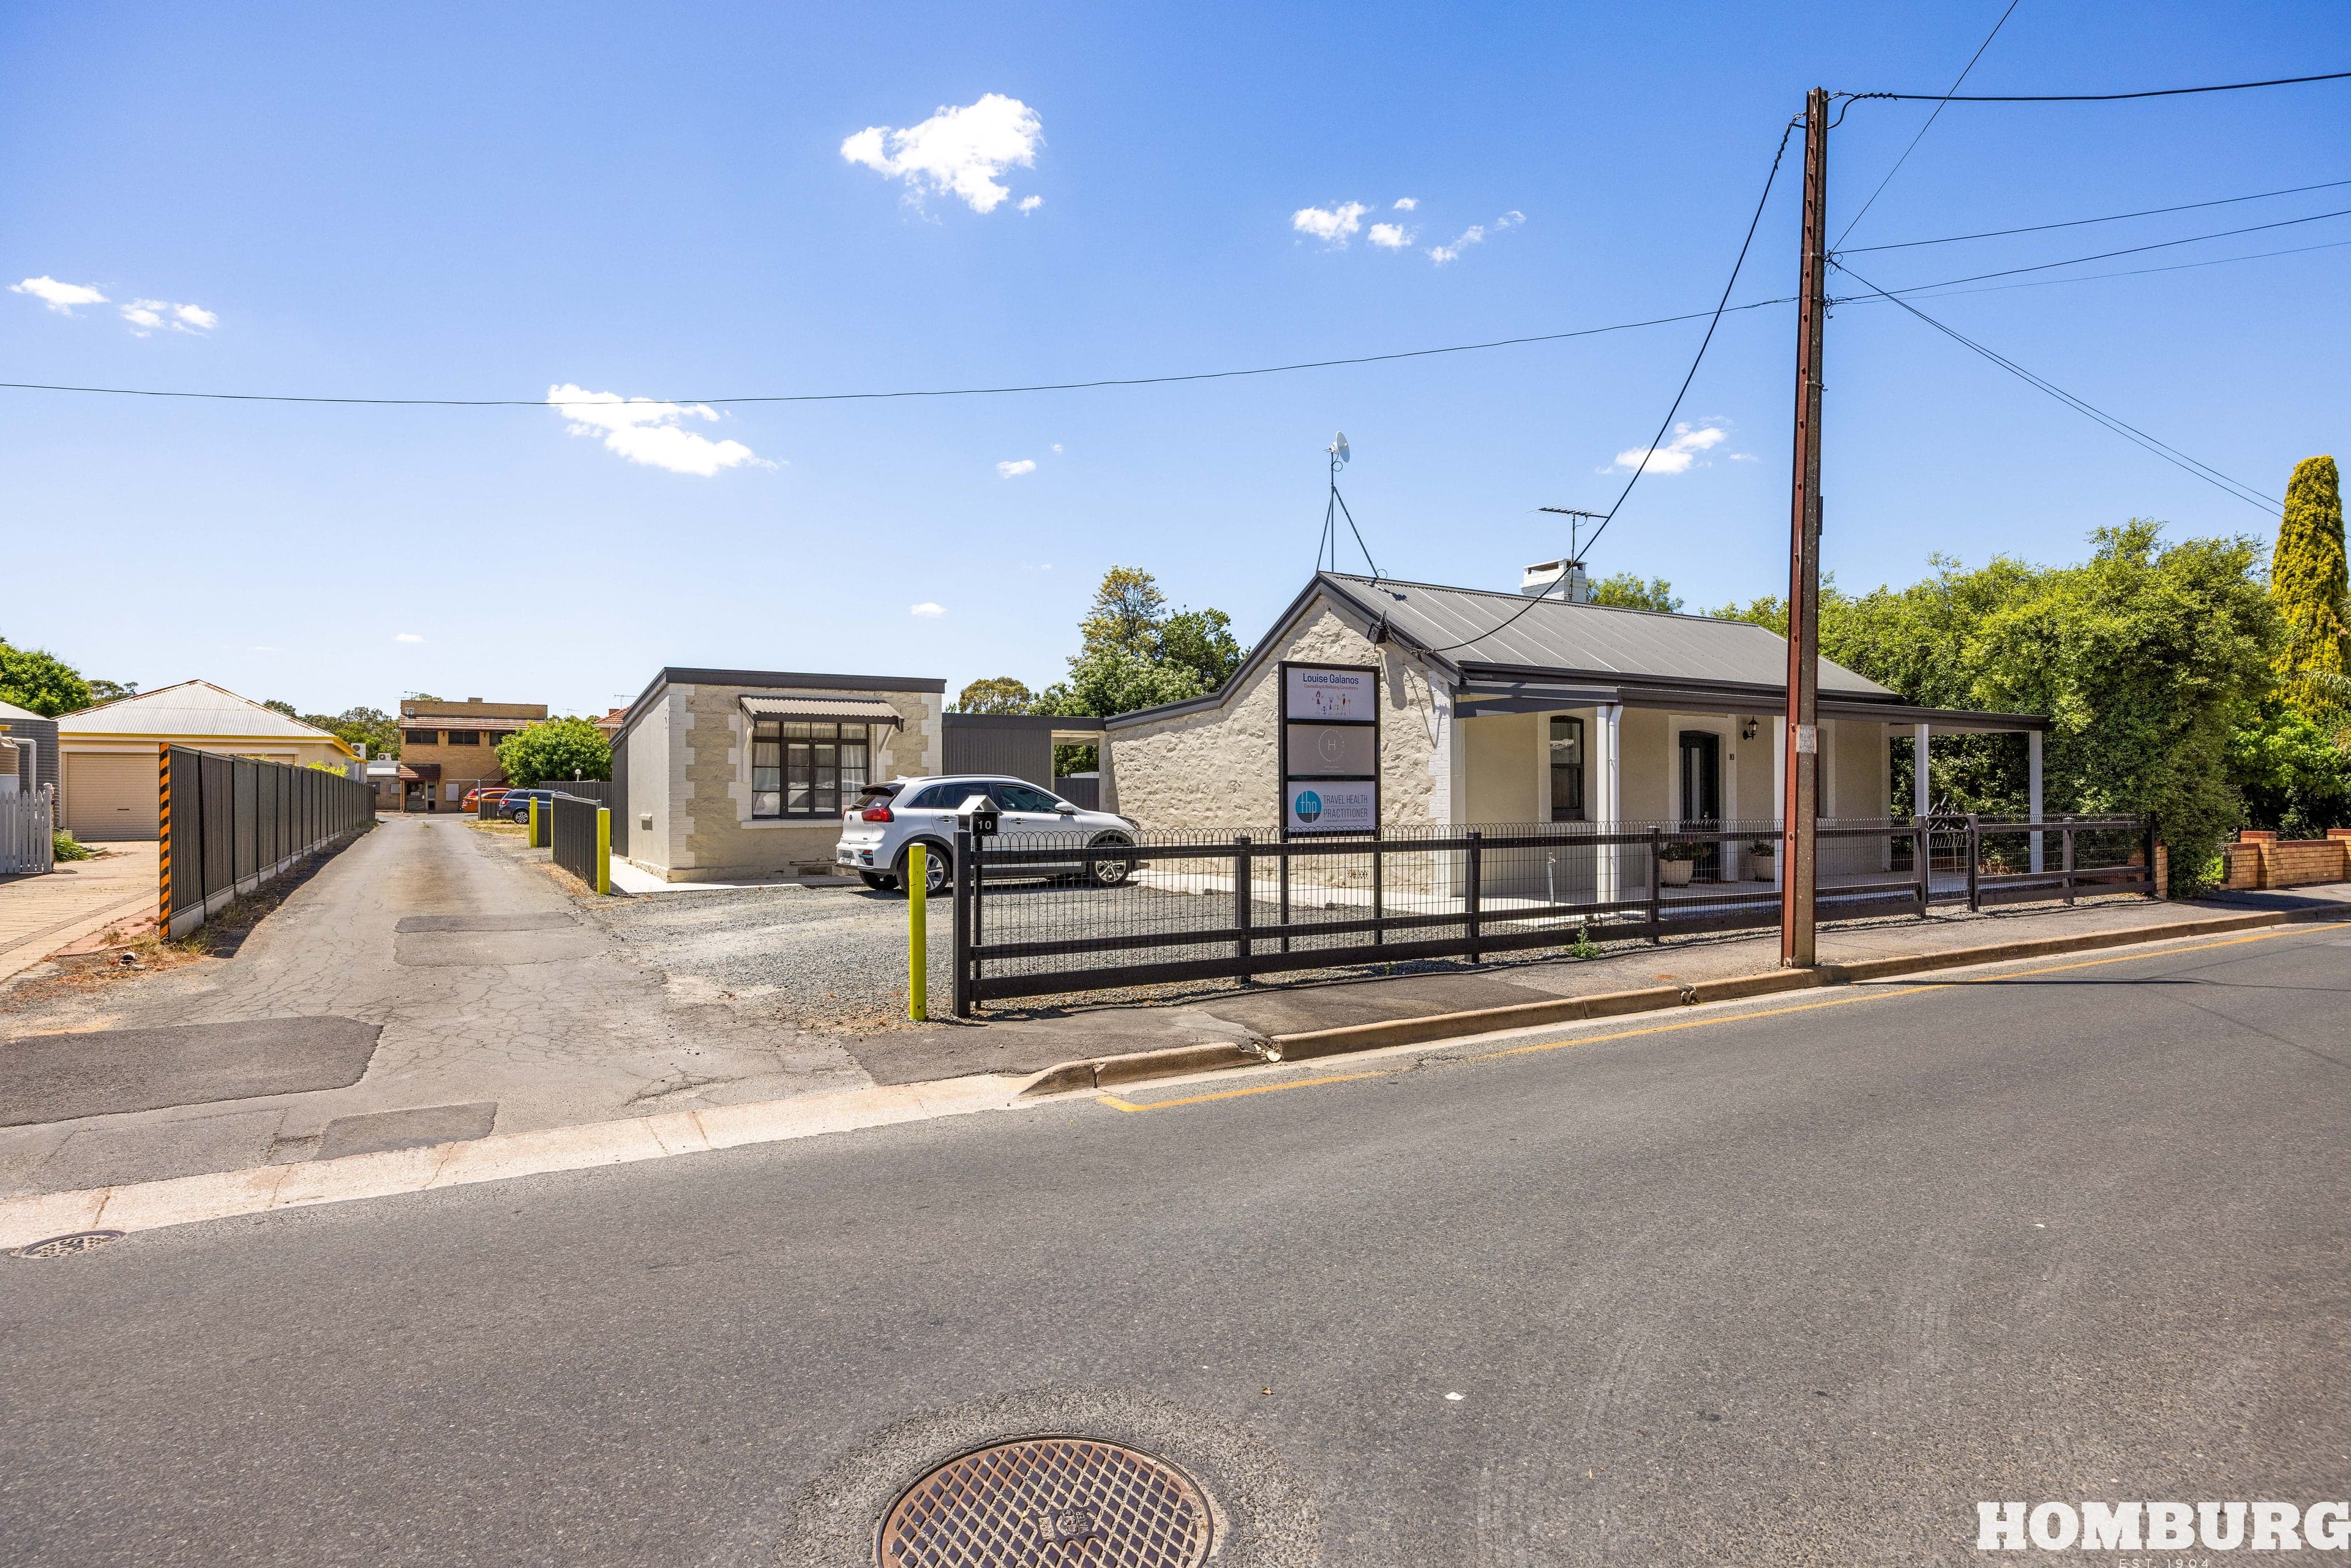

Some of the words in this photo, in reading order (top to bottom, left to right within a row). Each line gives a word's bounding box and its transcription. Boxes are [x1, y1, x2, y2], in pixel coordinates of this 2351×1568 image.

[1303, 673, 1328, 683] Louise
[1330, 674, 1359, 685] Galanos
[1328, 739, 1336, 751] H
[1323, 795, 1345, 804] TRAVEL
[1346, 795, 1368, 804] HEALTH
[1300, 790, 1317, 822] thp
[1323, 808, 1368, 818] PRACTITIONER
[978, 820, 992, 830] 10
[1076, 1510, 1090, 1534] WATER
